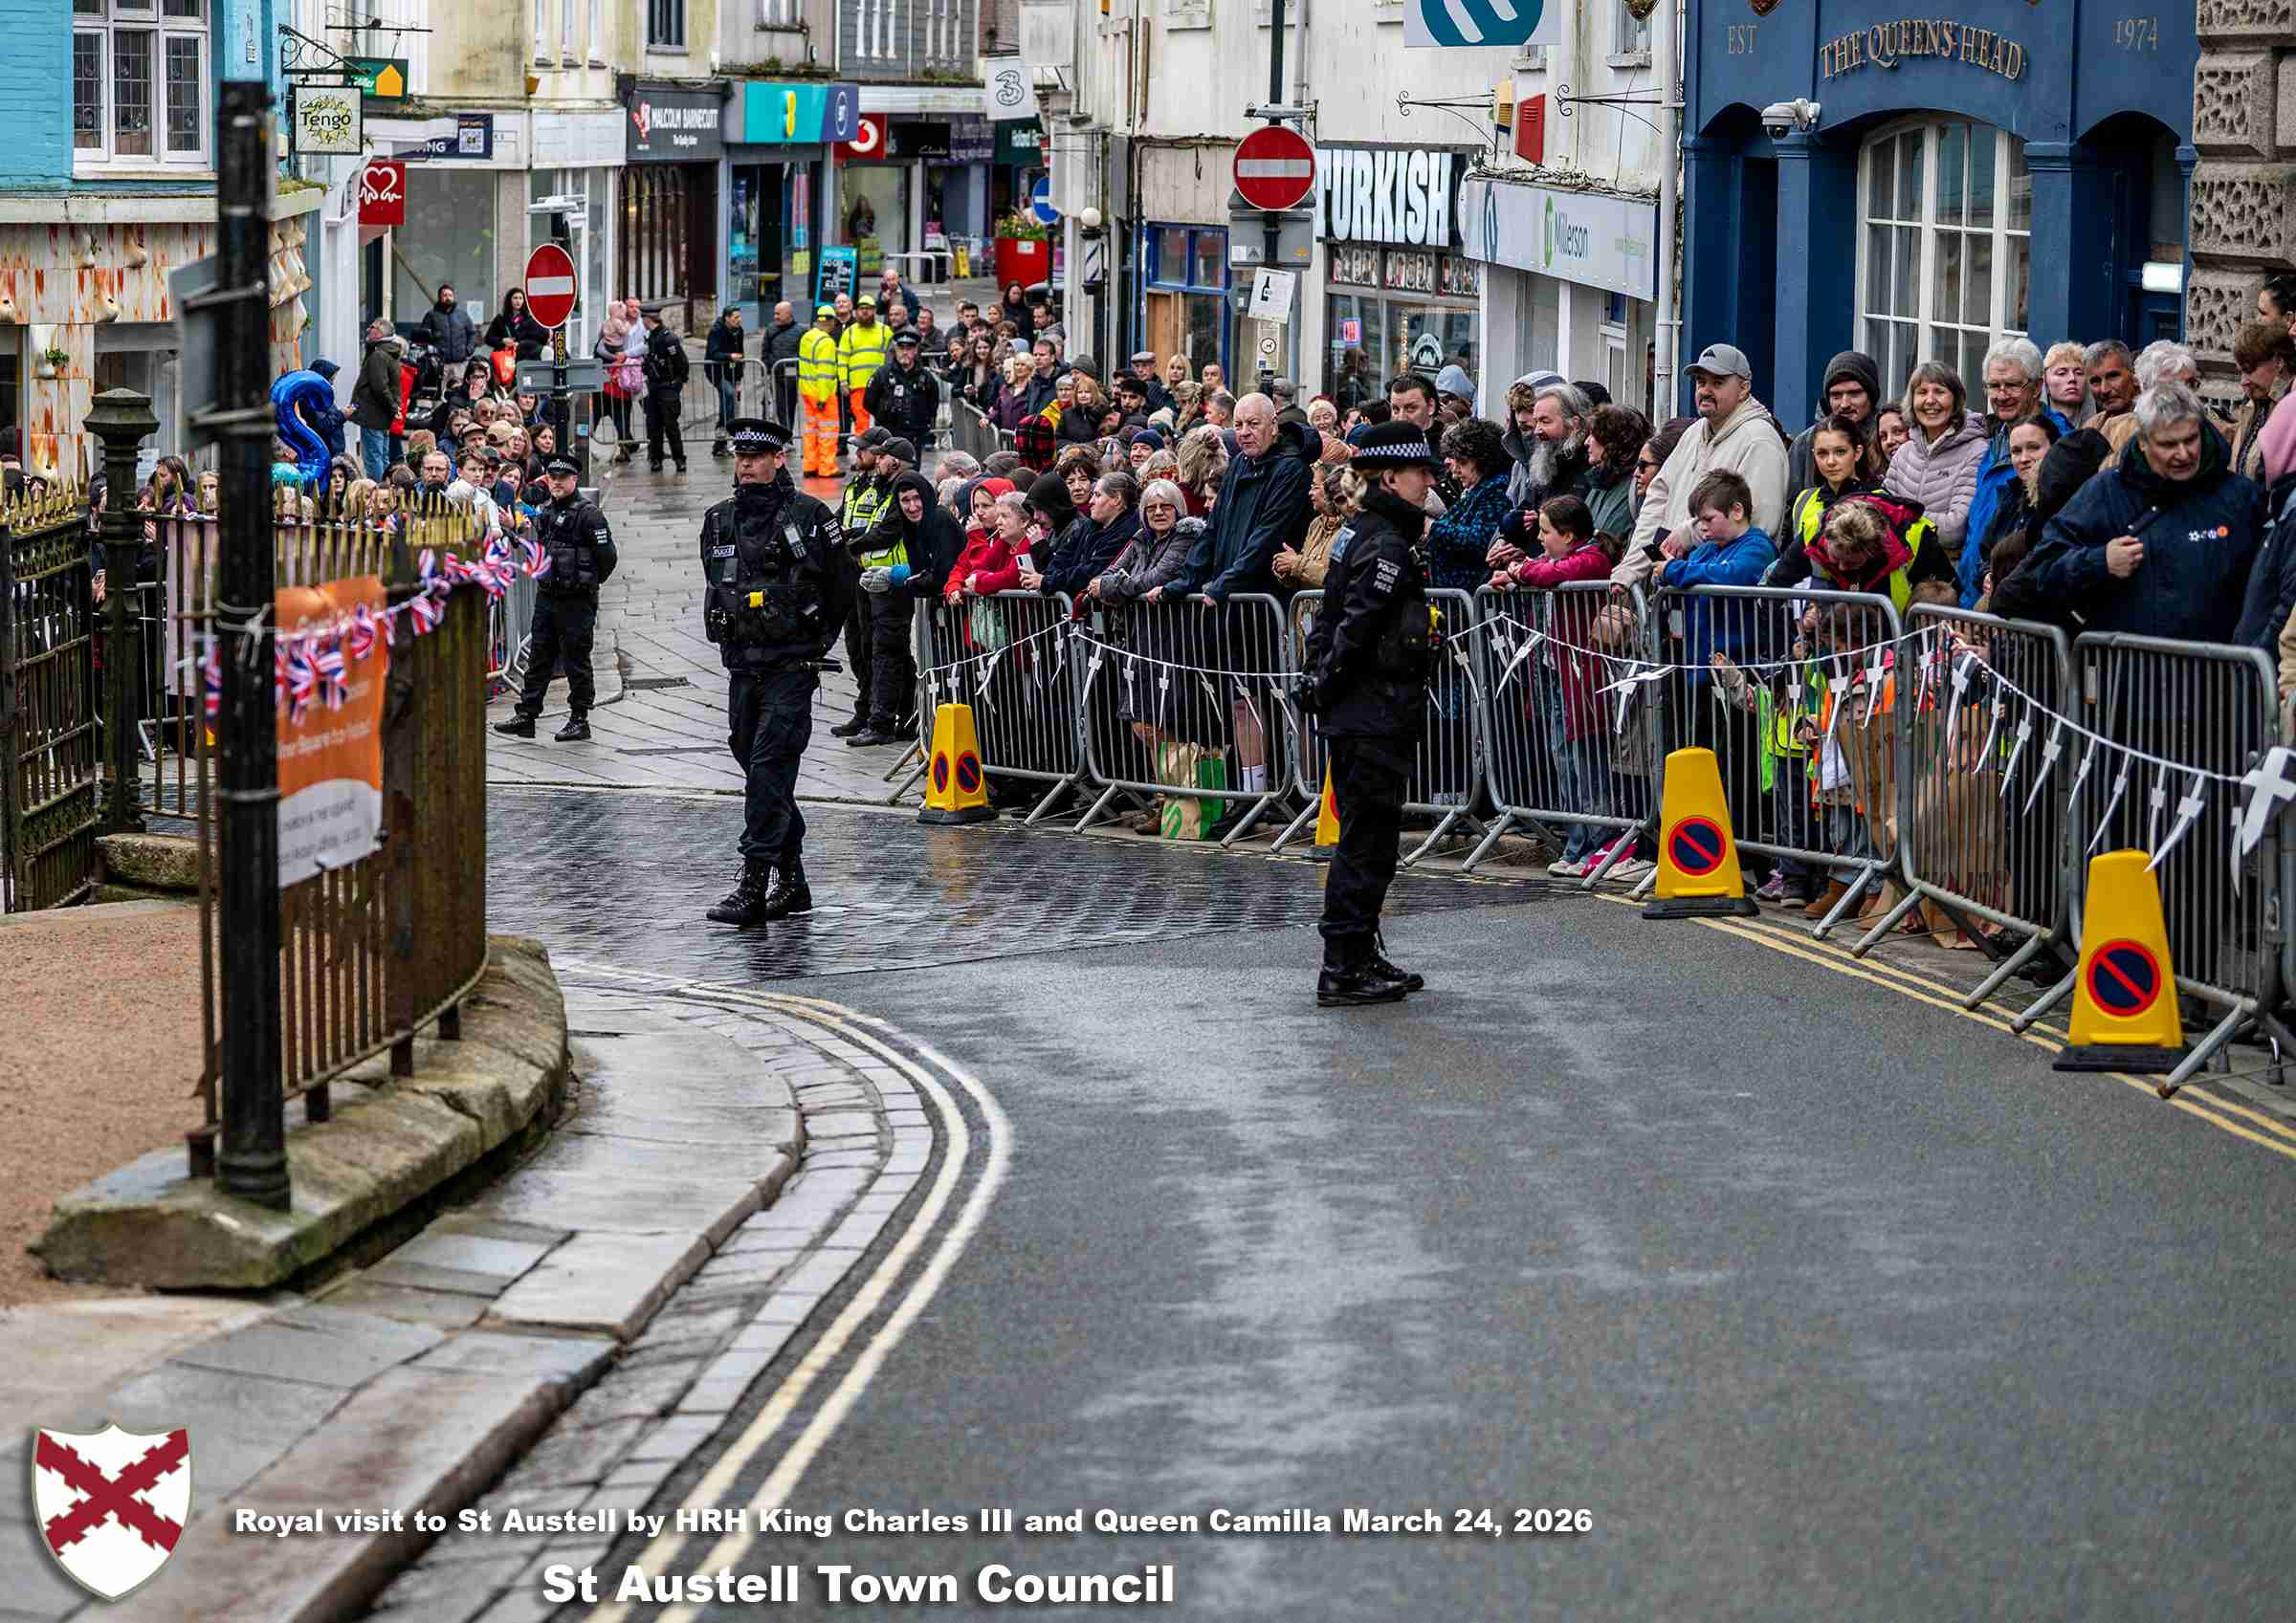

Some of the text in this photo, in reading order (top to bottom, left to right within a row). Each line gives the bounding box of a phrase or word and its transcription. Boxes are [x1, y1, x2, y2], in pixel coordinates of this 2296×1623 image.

[1729, 25, 1757, 55] EST
[1821, 19, 2024, 79] THE QUEENS HEAD
[2113, 16, 2158, 52] 1974
[995, 69, 1025, 106] 3
[299, 111, 351, 129] Tengo
[1315, 148, 1452, 247] TURKISH
[1554, 211, 1589, 259] Millerson
[1377, 562, 1400, 576] POLICE
